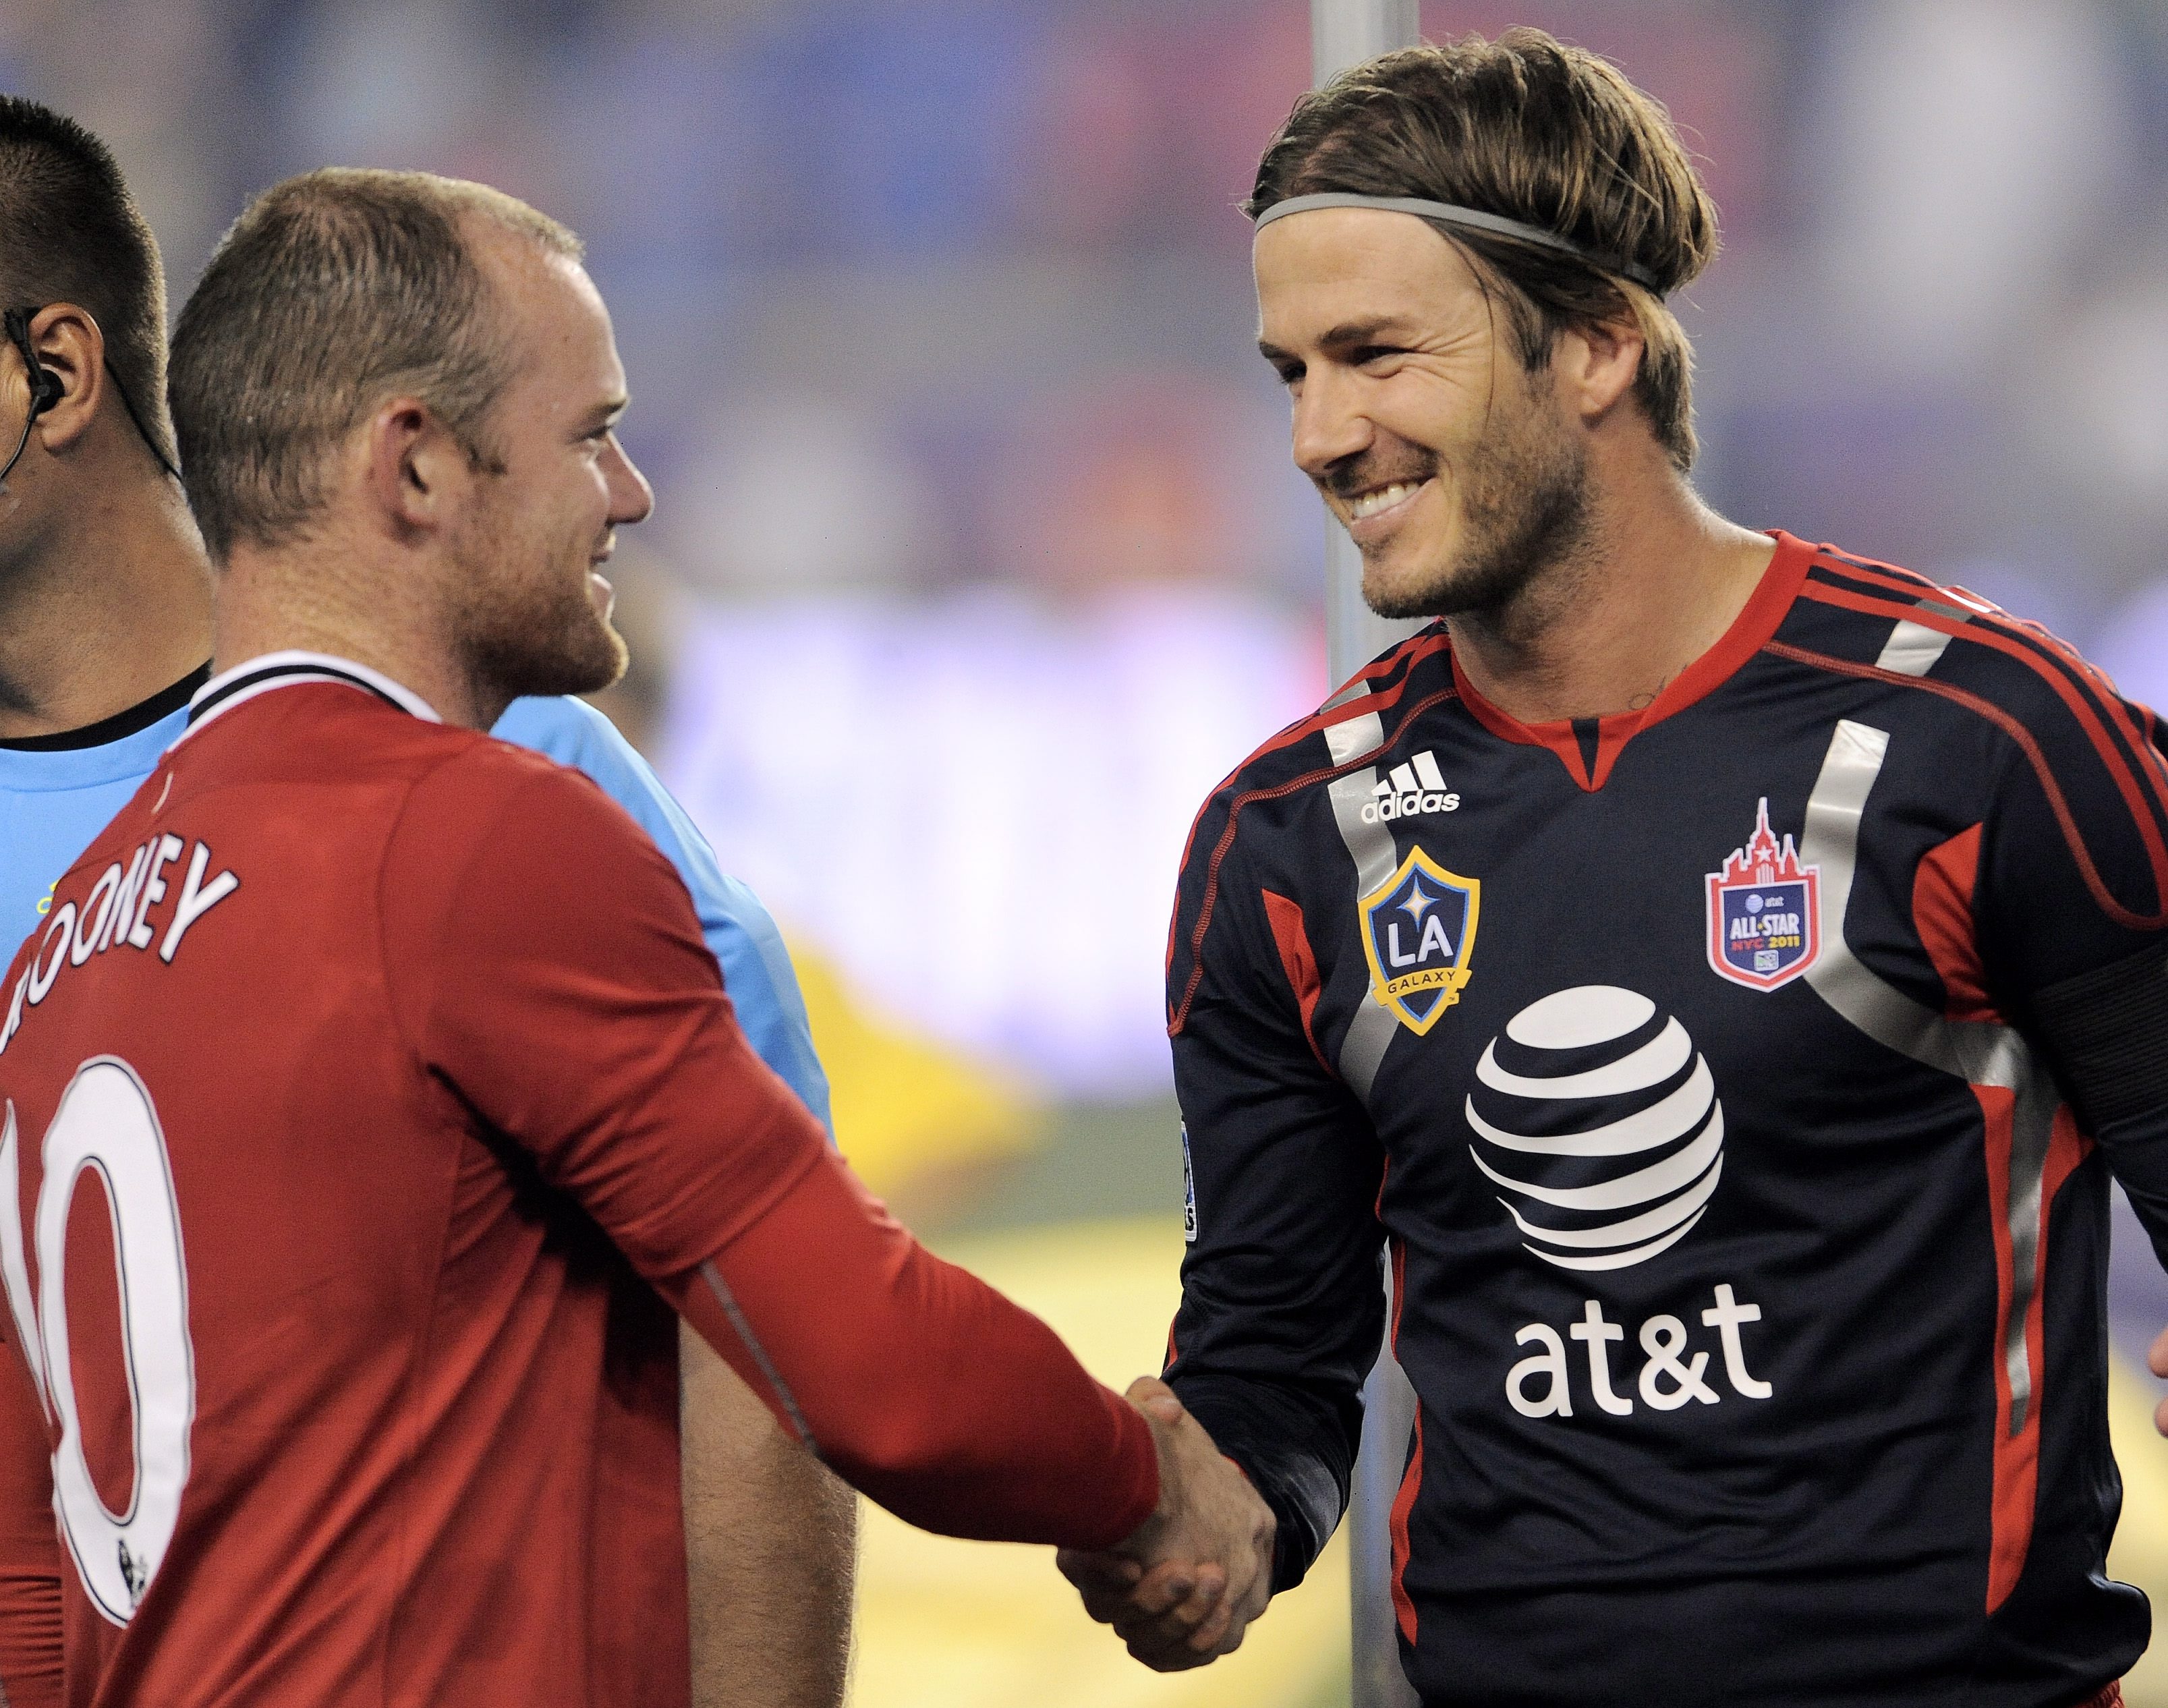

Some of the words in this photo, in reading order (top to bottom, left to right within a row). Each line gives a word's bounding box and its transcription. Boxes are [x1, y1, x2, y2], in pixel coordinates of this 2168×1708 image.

[1361, 789, 1460, 824] adidas
[1388, 914, 1454, 967] LA
[1769, 935, 1800, 948] 2011
[1388, 971, 1456, 994] GALAXY
[1505, 1283, 1773, 1418] at&t
